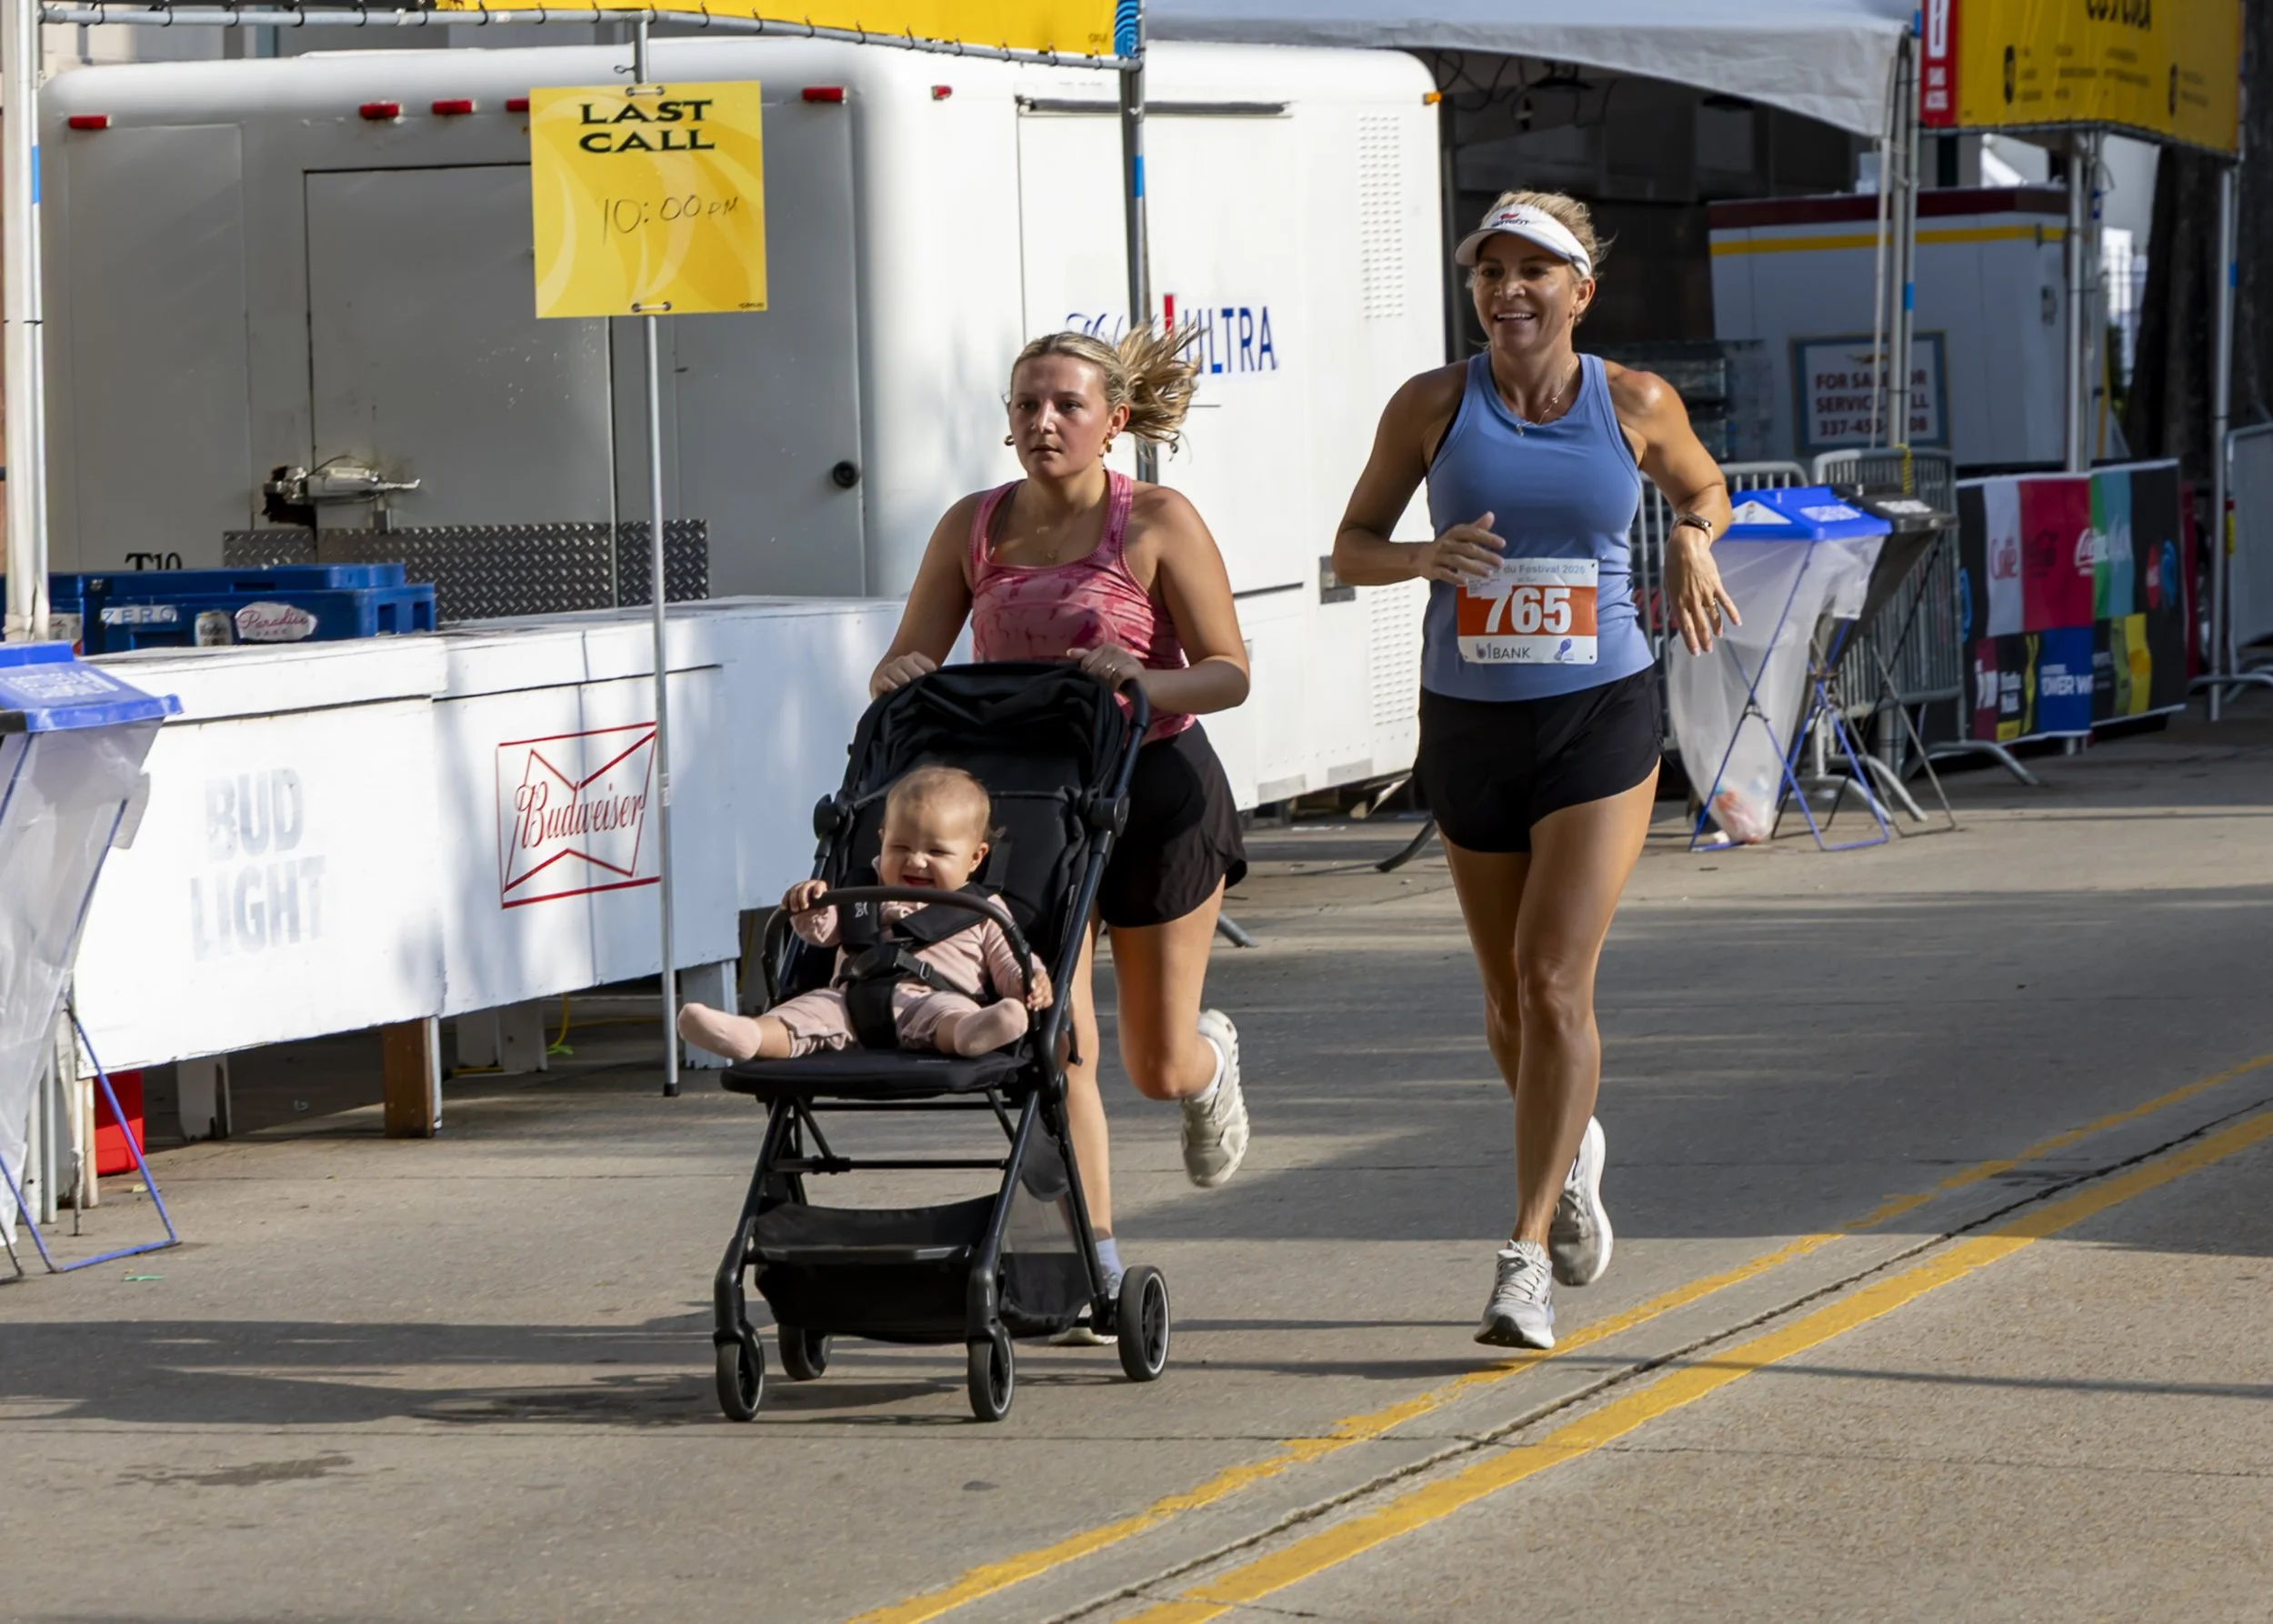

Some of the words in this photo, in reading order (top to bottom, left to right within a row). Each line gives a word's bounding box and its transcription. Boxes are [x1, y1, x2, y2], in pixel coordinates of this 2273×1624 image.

[579, 99, 713, 125] LAST
[579, 129, 716, 153] CALL
[603, 194, 702, 246] 10:00
[1184, 306, 1277, 375] ULTRA
[1816, 373, 1847, 390] FOR
[1503, 565, 1517, 575] du
[1519, 564, 1560, 575] Festival
[102, 606, 177, 625] ZERO
[237, 604, 309, 630] Paradise
[1481, 586, 1572, 635] 765
[205, 767, 305, 862] BUD
[516, 780, 646, 849] Budweiser
[190, 854, 326, 962] LIGHT
